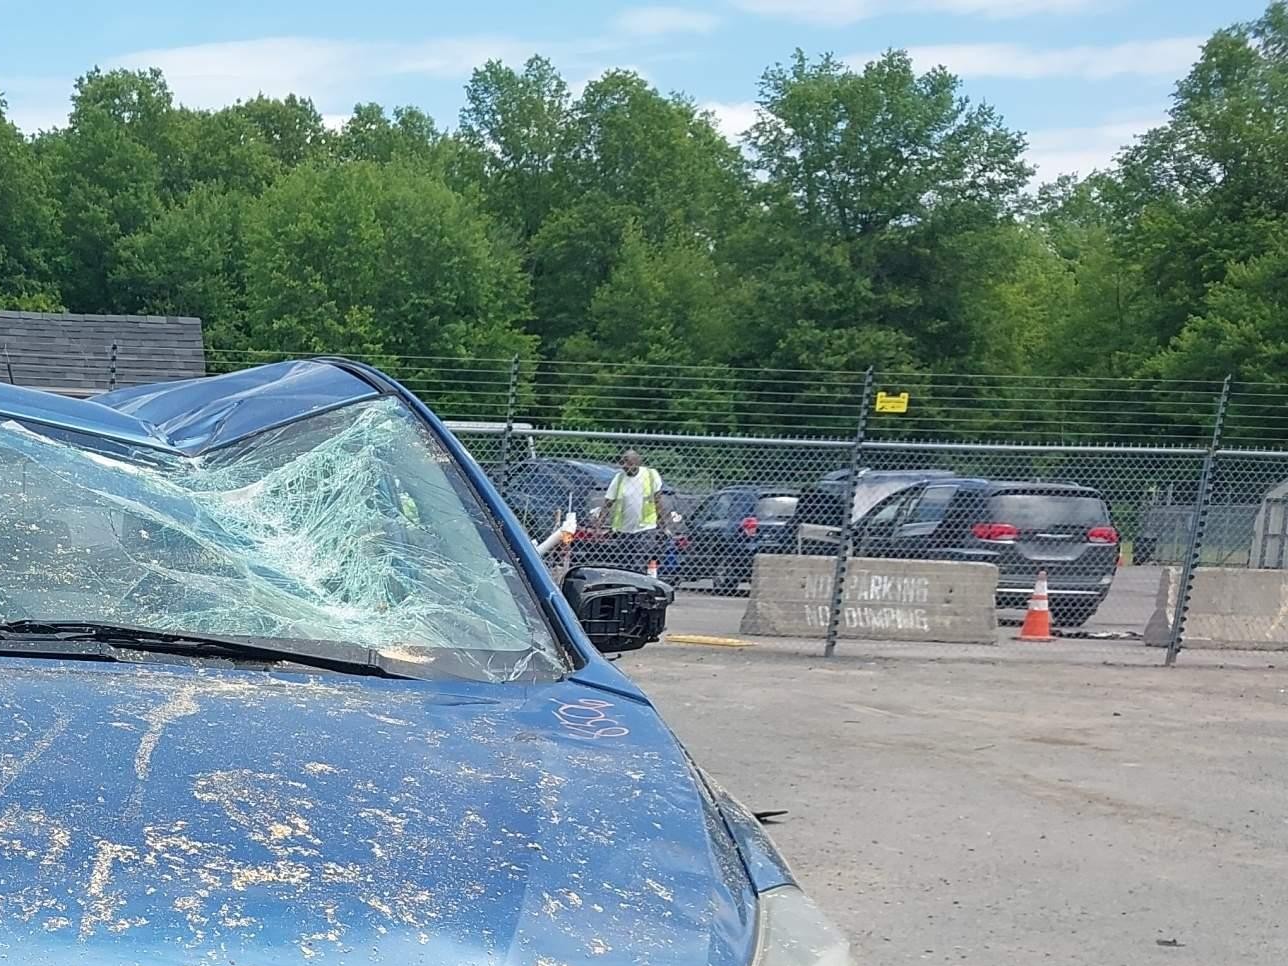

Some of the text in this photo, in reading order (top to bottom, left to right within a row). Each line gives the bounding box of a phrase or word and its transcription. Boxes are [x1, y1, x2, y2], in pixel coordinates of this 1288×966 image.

[804, 569, 929, 603] NO PARKING
[804, 605, 931, 632] NO DUMPING
